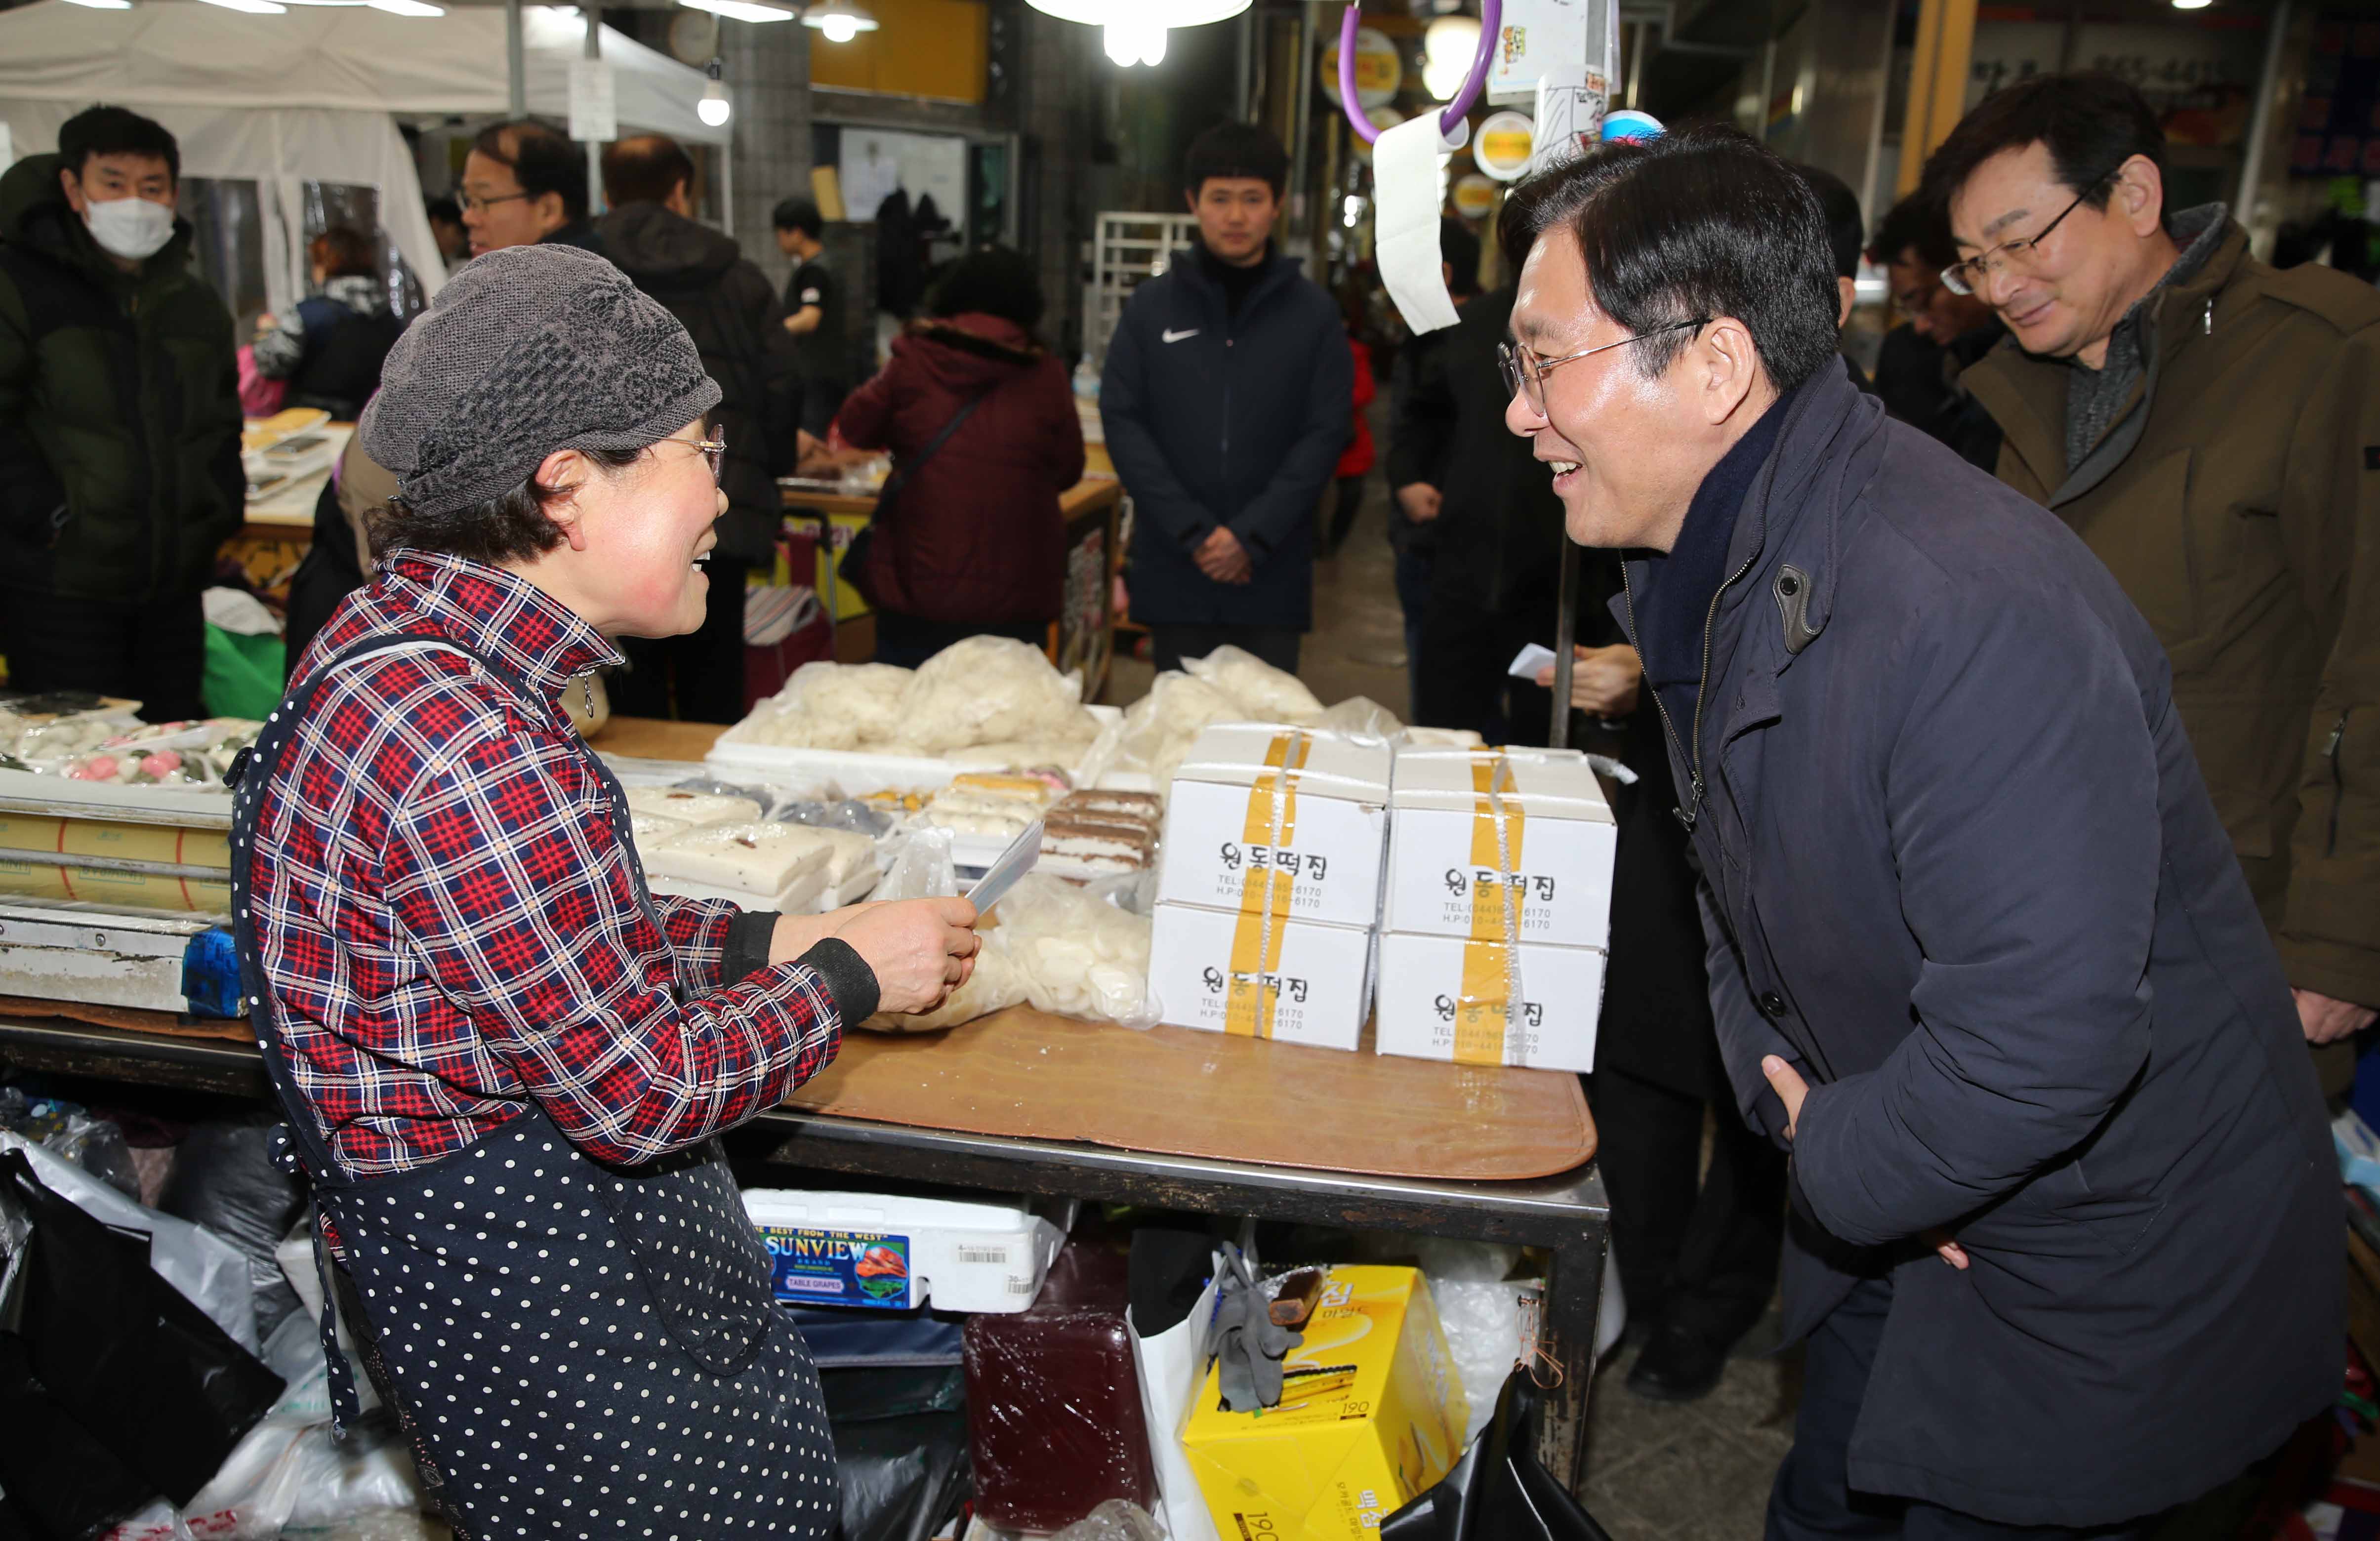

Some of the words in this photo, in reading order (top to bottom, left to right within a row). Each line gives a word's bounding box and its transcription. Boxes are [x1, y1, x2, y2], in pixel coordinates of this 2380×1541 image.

[766, 1236, 868, 1260] SUNVIEW
[790, 1278, 810, 1287] TABLE
[813, 1280, 841, 1290] GRAPES
[1343, 1401, 1370, 1414] 190
